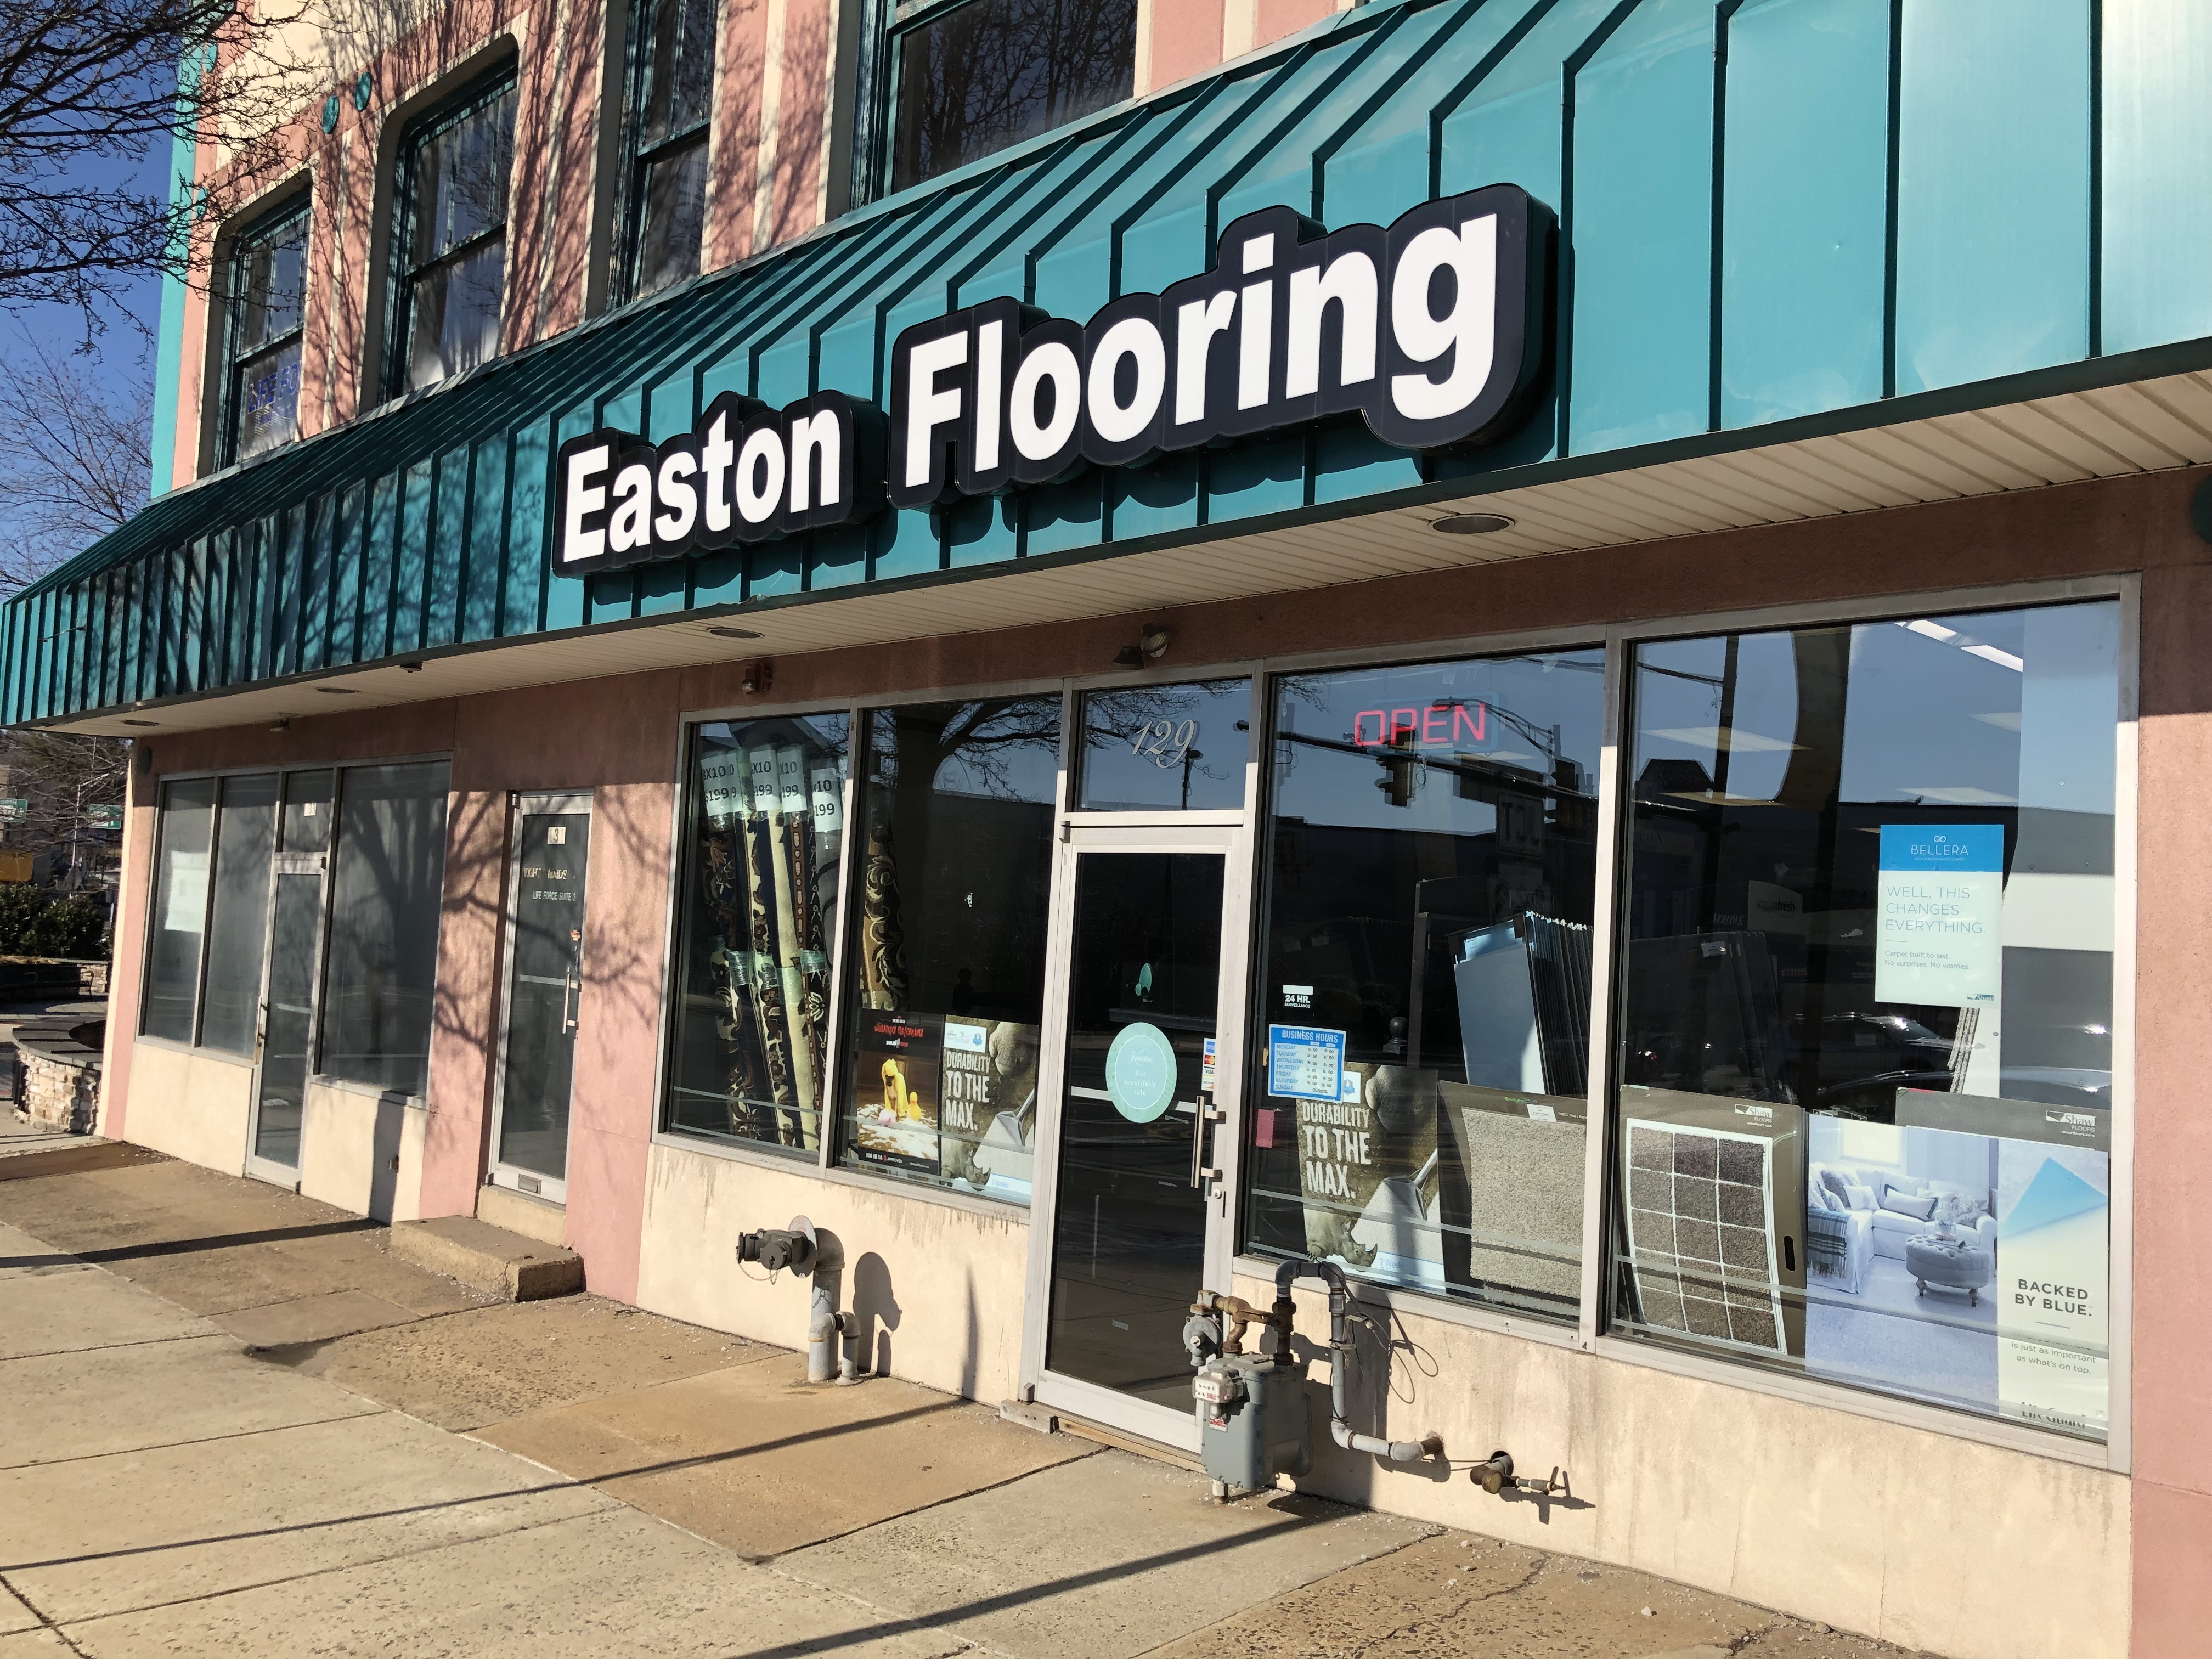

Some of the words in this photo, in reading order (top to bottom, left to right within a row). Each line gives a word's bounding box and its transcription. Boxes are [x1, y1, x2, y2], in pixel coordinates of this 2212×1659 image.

[248, 372, 277, 415] LIFE
[280, 362, 302, 400] FO
[563, 409, 841, 562] Easton
[905, 213, 1497, 488] Flooring
[1354, 703, 1486, 747] OPEN
[1132, 719, 1194, 768] 129
[753, 783, 772, 797] 199
[1911, 844, 1968, 855] BELLERA
[533, 891, 542, 899] LIFE
[543, 891, 557, 900] FORCE
[559, 892, 571, 901] SUITE
[572, 893, 577, 901] 2
[1887, 886, 1931, 899] WELL,
[1937, 887, 1970, 899] THIS
[1886, 902, 1959, 915] CHANGES
[1886, 919, 1985, 934] EVERYTHING.
[1884, 950, 1908, 958] Carpet
[1896, 960, 1928, 968] surprises.
[1297, 995, 1311, 1003] HR.
[1282, 1030, 1314, 1041] BUSINESS
[1316, 1033, 1338, 1043] HOURS
[946, 1051, 991, 1073] DURABILITY
[945, 1070, 962, 1098] TO
[964, 1073, 990, 1103] THE
[1124, 1079, 1157, 1088] beautifully
[945, 1099, 978, 1131] MAX.
[1302, 1101, 1369, 1128] DURABILITY
[1750, 1108, 1771, 1118] Shaw
[2065, 1115, 2094, 1126] Shaw
[1302, 1125, 1329, 1159] TO
[1332, 1127, 1372, 1165] THE
[1306, 1160, 1356, 1199] MAX.
[2018, 1279, 2089, 1300] BACKED
[2015, 1293, 2036, 1306] BY
[2042, 1298, 2092, 1317] BLUE.
[2020, 1343, 2036, 1352] just
[2039, 1347, 2049, 1355] as
[2051, 1348, 2096, 1363] important
[2029, 1357, 2057, 1368] what's
[2073, 1365, 2091, 1375] top.
